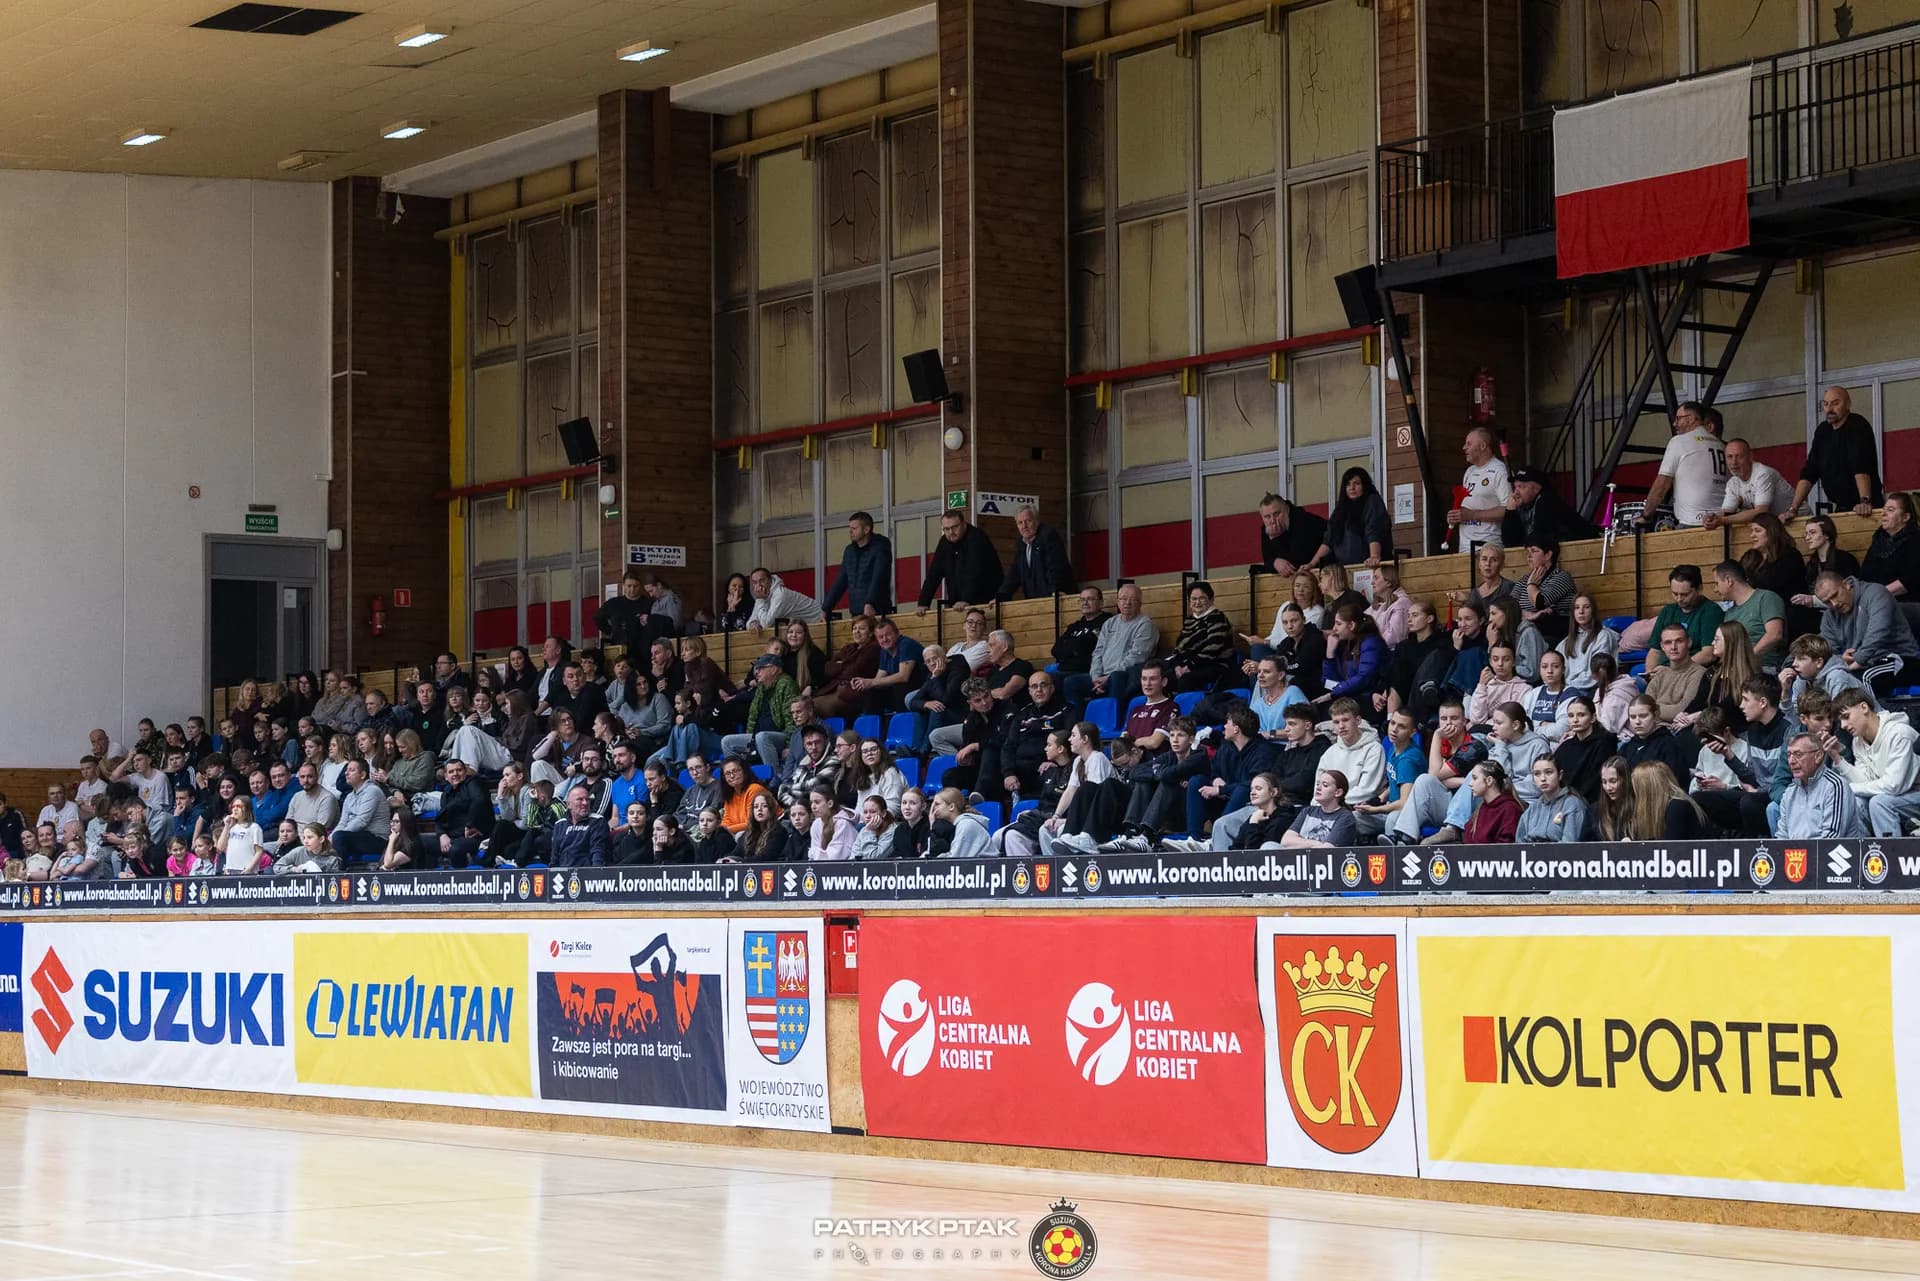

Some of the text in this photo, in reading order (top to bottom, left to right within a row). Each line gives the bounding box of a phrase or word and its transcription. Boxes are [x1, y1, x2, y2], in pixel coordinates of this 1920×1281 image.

[981, 494, 1035, 503] SEKTOR
[981, 501, 1000, 513] A
[630, 552, 646, 563] B
[631, 546, 681, 554] SEKTOR
[1108, 855, 1333, 888] www.koronahandball.pl
[1458, 848, 1740, 886] www.koronahandball.pl
[211, 879, 326, 903] www.koronahandball.pl
[384, 874, 514, 900] www.koronahandball.pl
[584, 870, 738, 898] www.koronahandball.pl
[822, 864, 1006, 895] www.koronahandball.pl
[0, 887, 20, 908] all.pl
[63, 884, 162, 906] www.koronahandball.pl
[561, 941, 592, 952] Targi Kielce
[83, 969, 285, 1047] SUZUKI
[347, 975, 514, 1043] LEWIATAN
[938, 996, 972, 1016] LIGA
[1134, 1000, 1174, 1022] LIGA
[938, 1023, 1031, 1046] CENTRALNA
[1134, 1029, 1242, 1054] CENTRALNA
[552, 1036, 692, 1061] Zawsze jest pora na targi...
[939, 1049, 993, 1070] KOBIET
[1499, 1016, 1842, 1098] KOLPORTER
[553, 1061, 619, 1080] i kibicowanie
[1135, 1057, 1198, 1080] KOBIET
[1291, 1021, 1379, 1127] CK
[739, 1078, 824, 1098] WOJEWÓDZTWO
[739, 1098, 825, 1120] ŚWIĘTOKRZYSKIE
